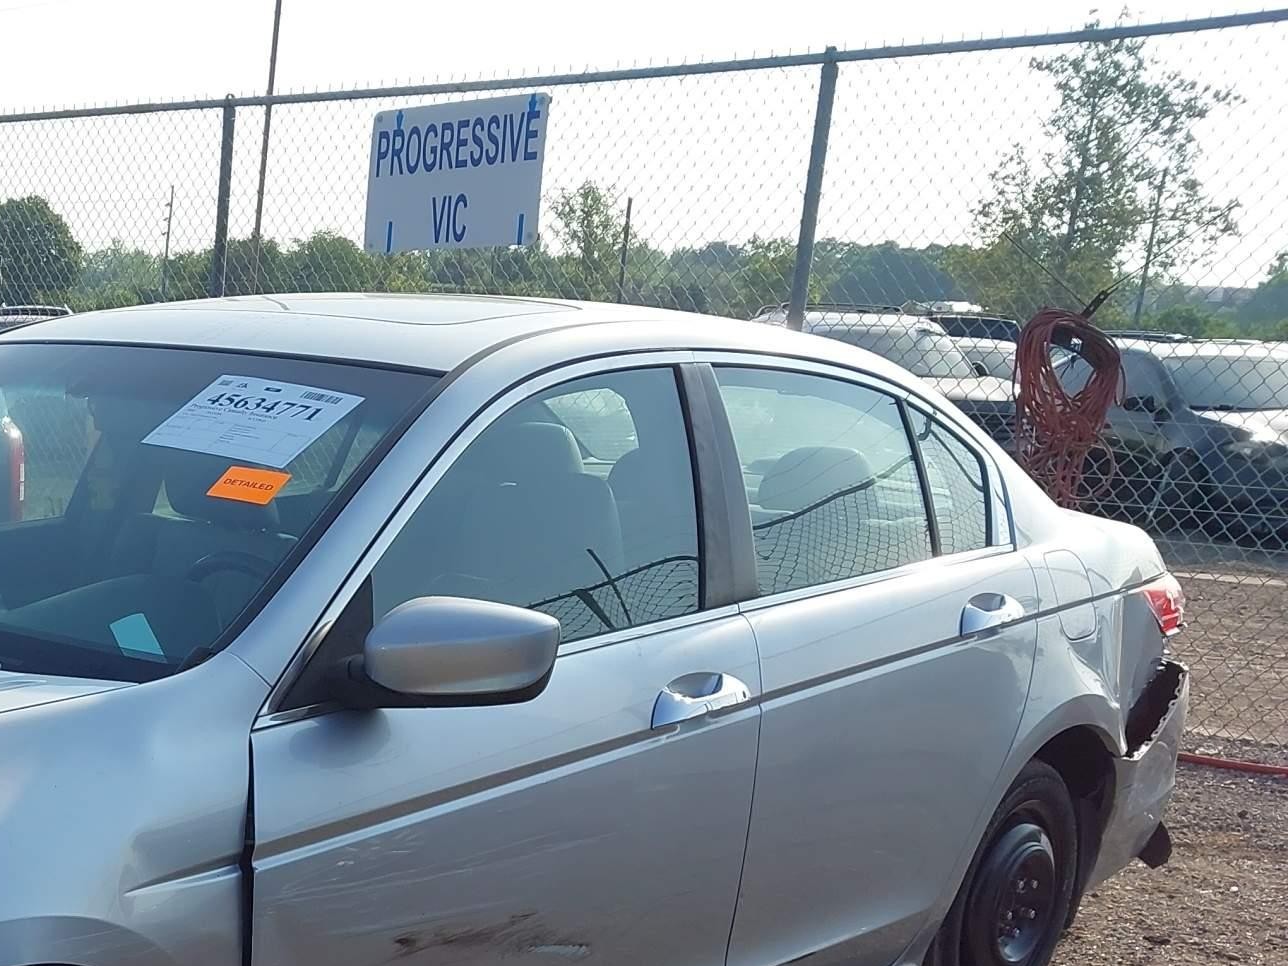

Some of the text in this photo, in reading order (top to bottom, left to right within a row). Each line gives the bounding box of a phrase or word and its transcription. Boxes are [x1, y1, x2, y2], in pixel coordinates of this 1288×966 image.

[375, 110, 541, 178] PROGRESSIVE
[432, 193, 468, 244] VIC
[206, 392, 324, 423] 45634771
[222, 477, 275, 492] DETAILED
